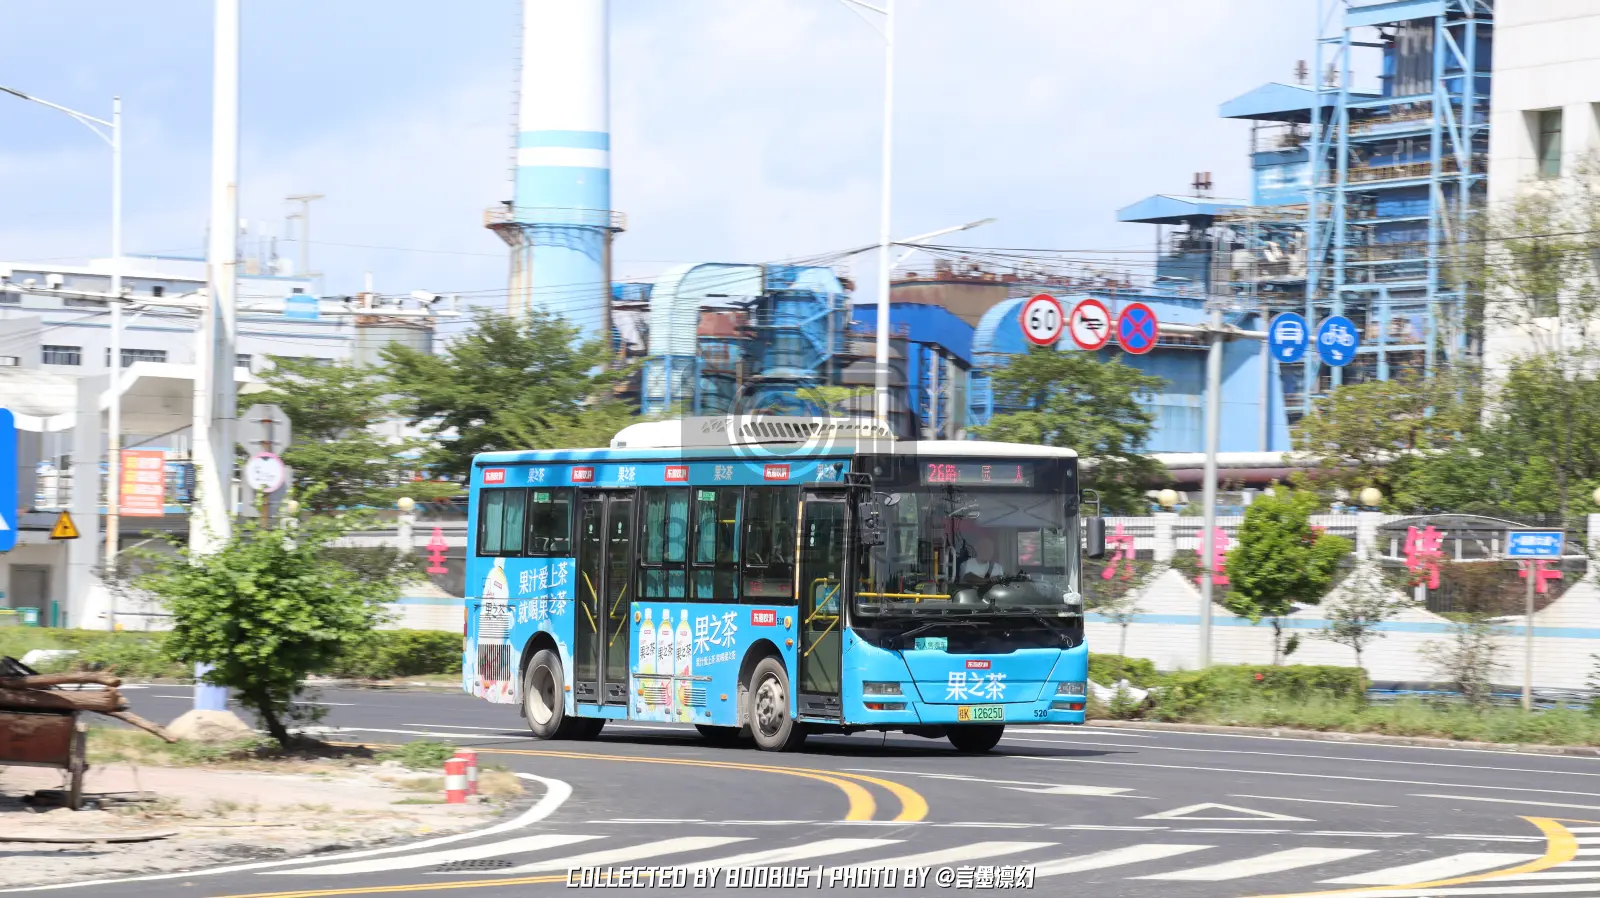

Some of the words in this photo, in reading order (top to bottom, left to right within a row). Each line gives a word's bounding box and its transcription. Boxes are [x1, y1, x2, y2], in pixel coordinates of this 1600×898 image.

[1031, 308, 1055, 331] 60
[528, 468, 545, 482] 果之茶
[618, 467, 636, 482] 果之茶
[715, 464, 733, 480] 果之茶
[518, 562, 568, 595] 果汁爱上茶
[517, 591, 567, 624] 就喝果之茶
[694, 611, 738, 655] 果之茶
[945, 671, 1007, 701] 果之茶
[1034, 709, 1048, 718] 520
